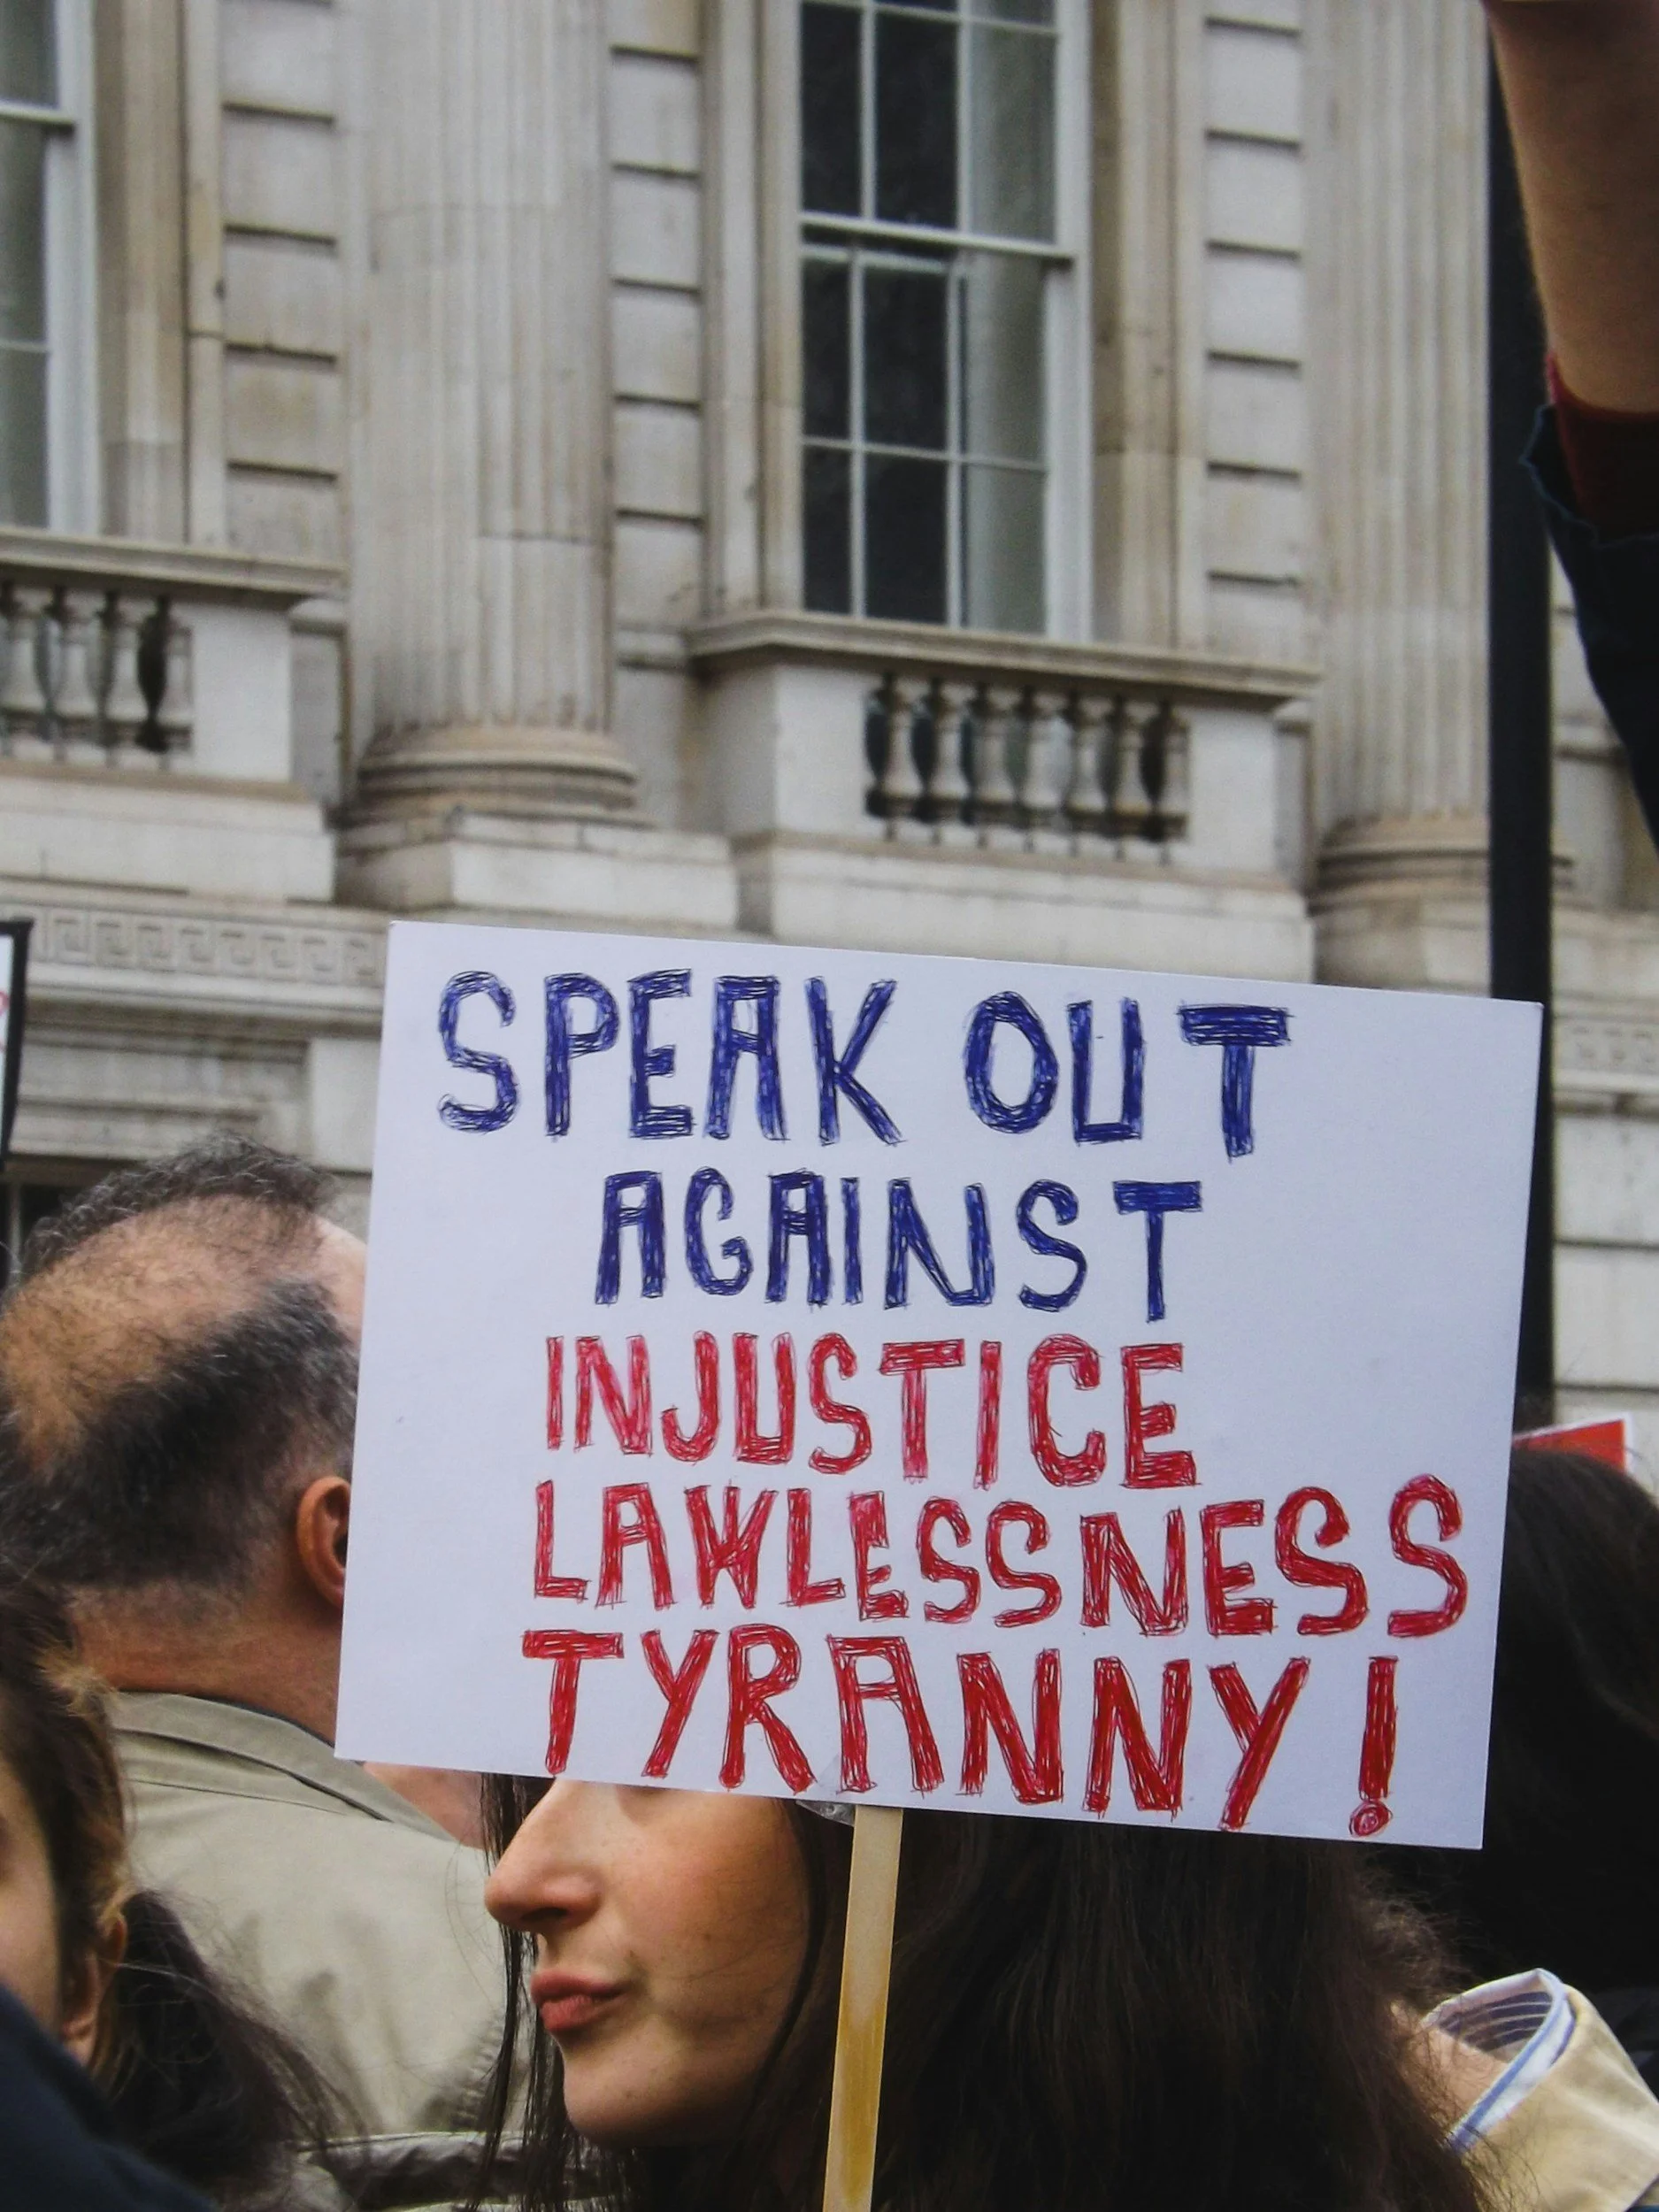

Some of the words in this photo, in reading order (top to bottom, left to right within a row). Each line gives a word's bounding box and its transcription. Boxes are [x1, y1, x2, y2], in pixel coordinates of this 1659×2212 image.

[436, 967, 907, 1148] SPEAK
[961, 989, 1296, 1164] OUT
[593, 1165, 1204, 1325] AGAINST
[544, 1329, 1203, 1493] INJUSTICE
[533, 1471, 1470, 1641] LAWLESSNESS
[520, 1623, 1401, 1834] TYRANNY!
